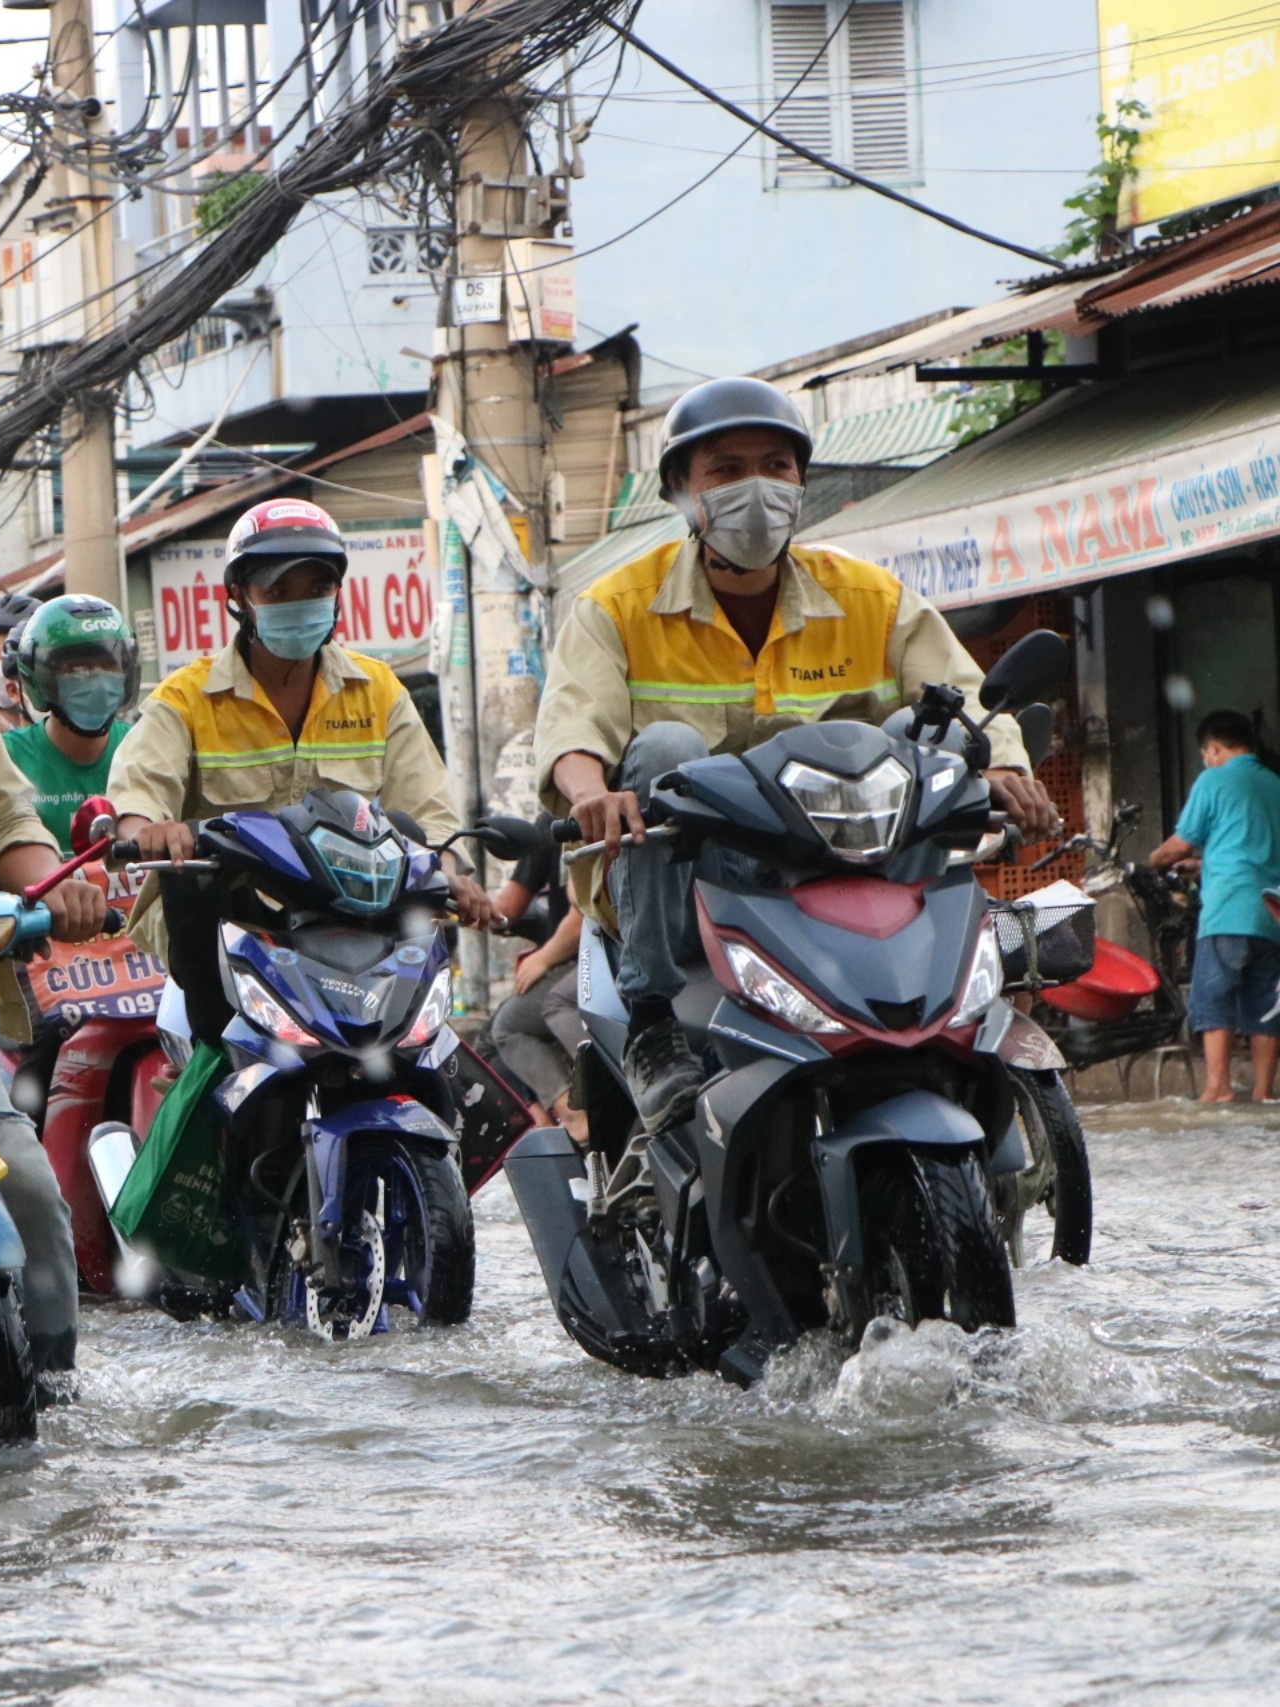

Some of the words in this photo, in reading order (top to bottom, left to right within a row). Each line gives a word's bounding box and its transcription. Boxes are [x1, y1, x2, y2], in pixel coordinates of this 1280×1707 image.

[986, 514, 1028, 586] A
[1034, 476, 1169, 575] NAM
[81, 616, 120, 632] Grab
[46, 955, 117, 994] CỨU
